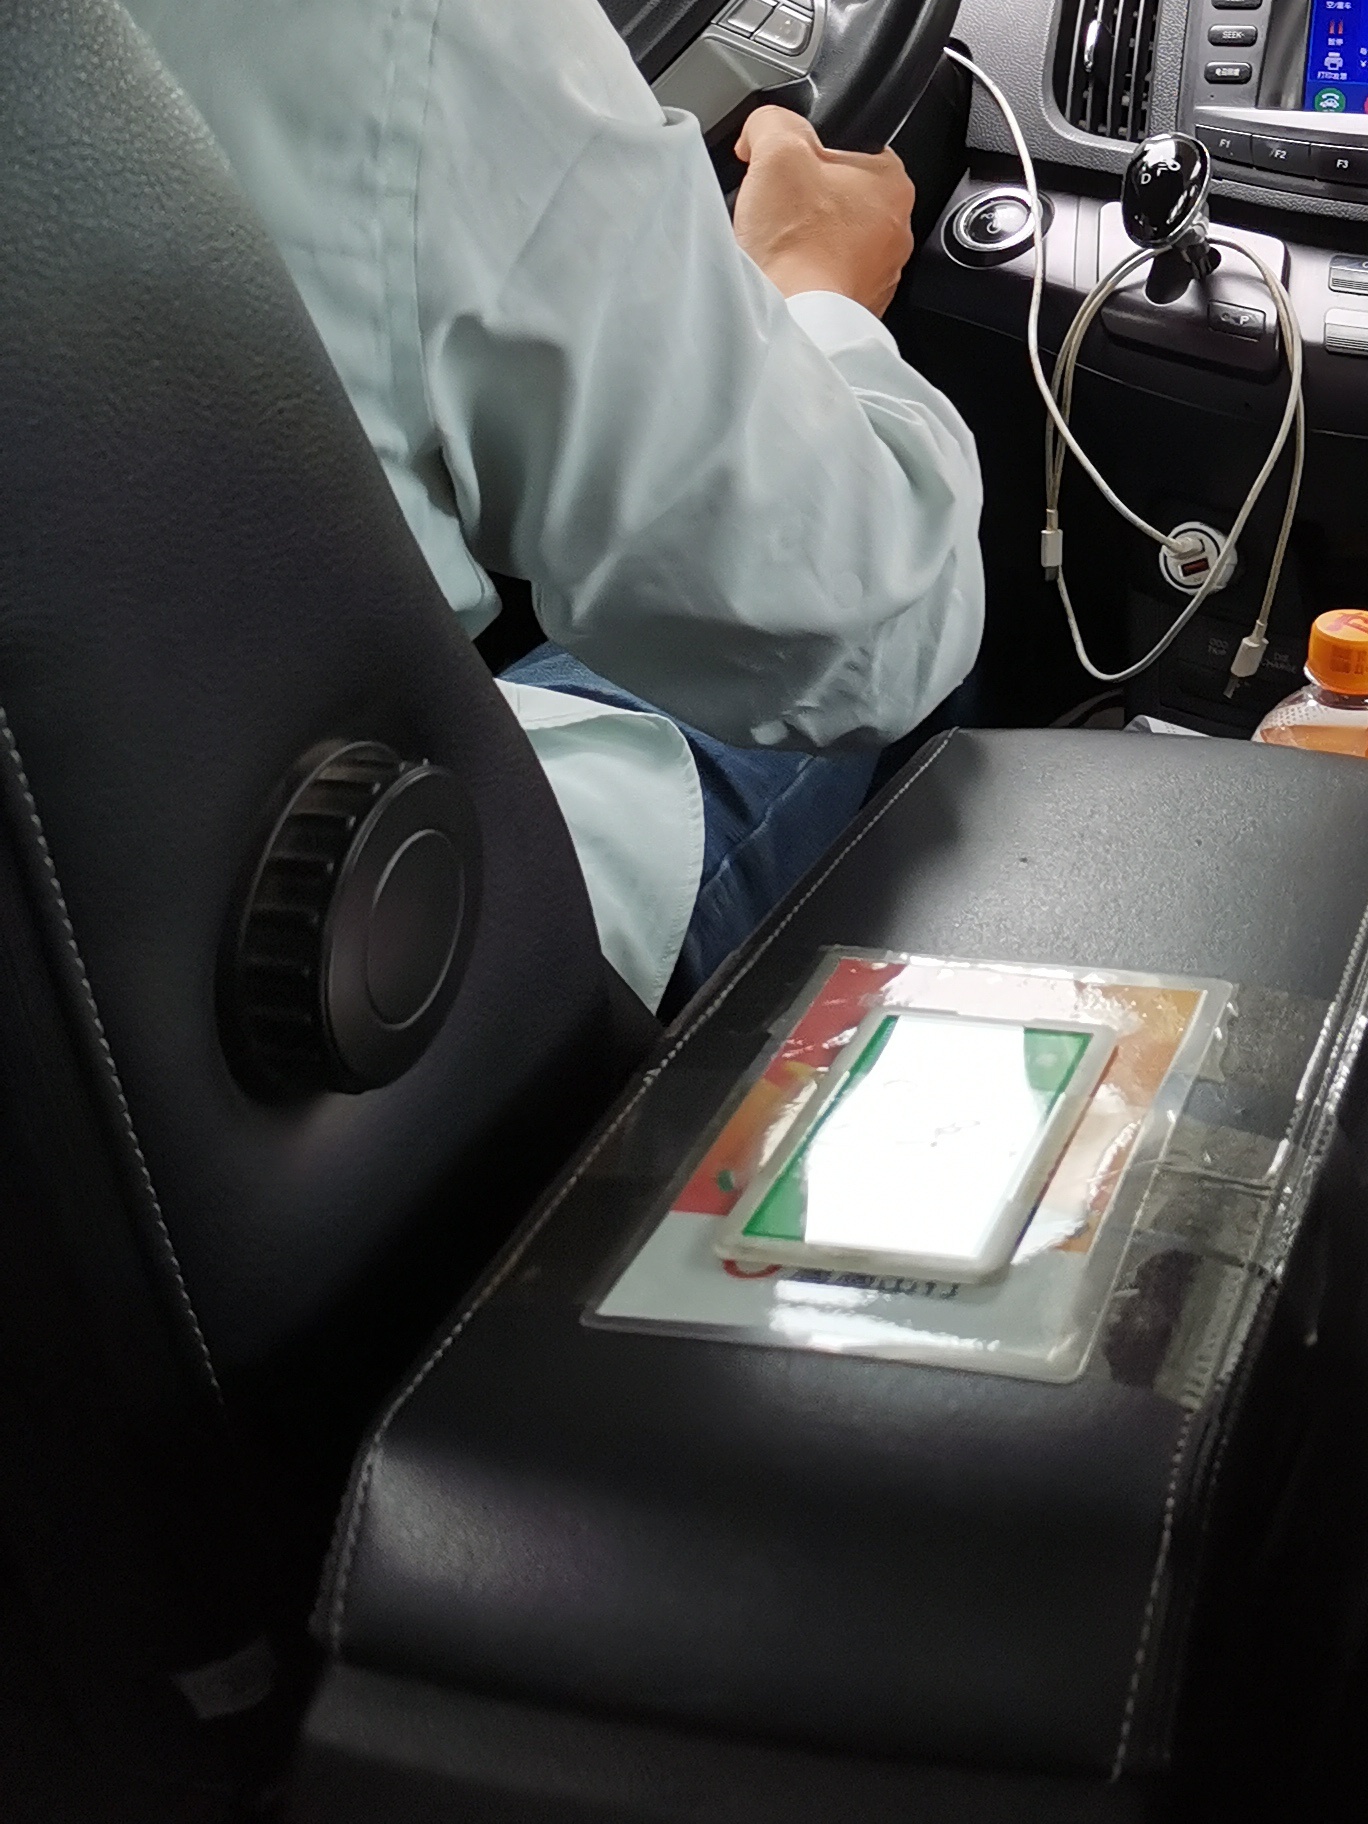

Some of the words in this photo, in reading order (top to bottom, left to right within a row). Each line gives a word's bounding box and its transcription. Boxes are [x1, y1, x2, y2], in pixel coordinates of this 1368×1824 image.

[1219, 138, 1231, 149] F1
[1274, 149, 1287, 160] F2
[1336, 159, 1349, 169] F3
